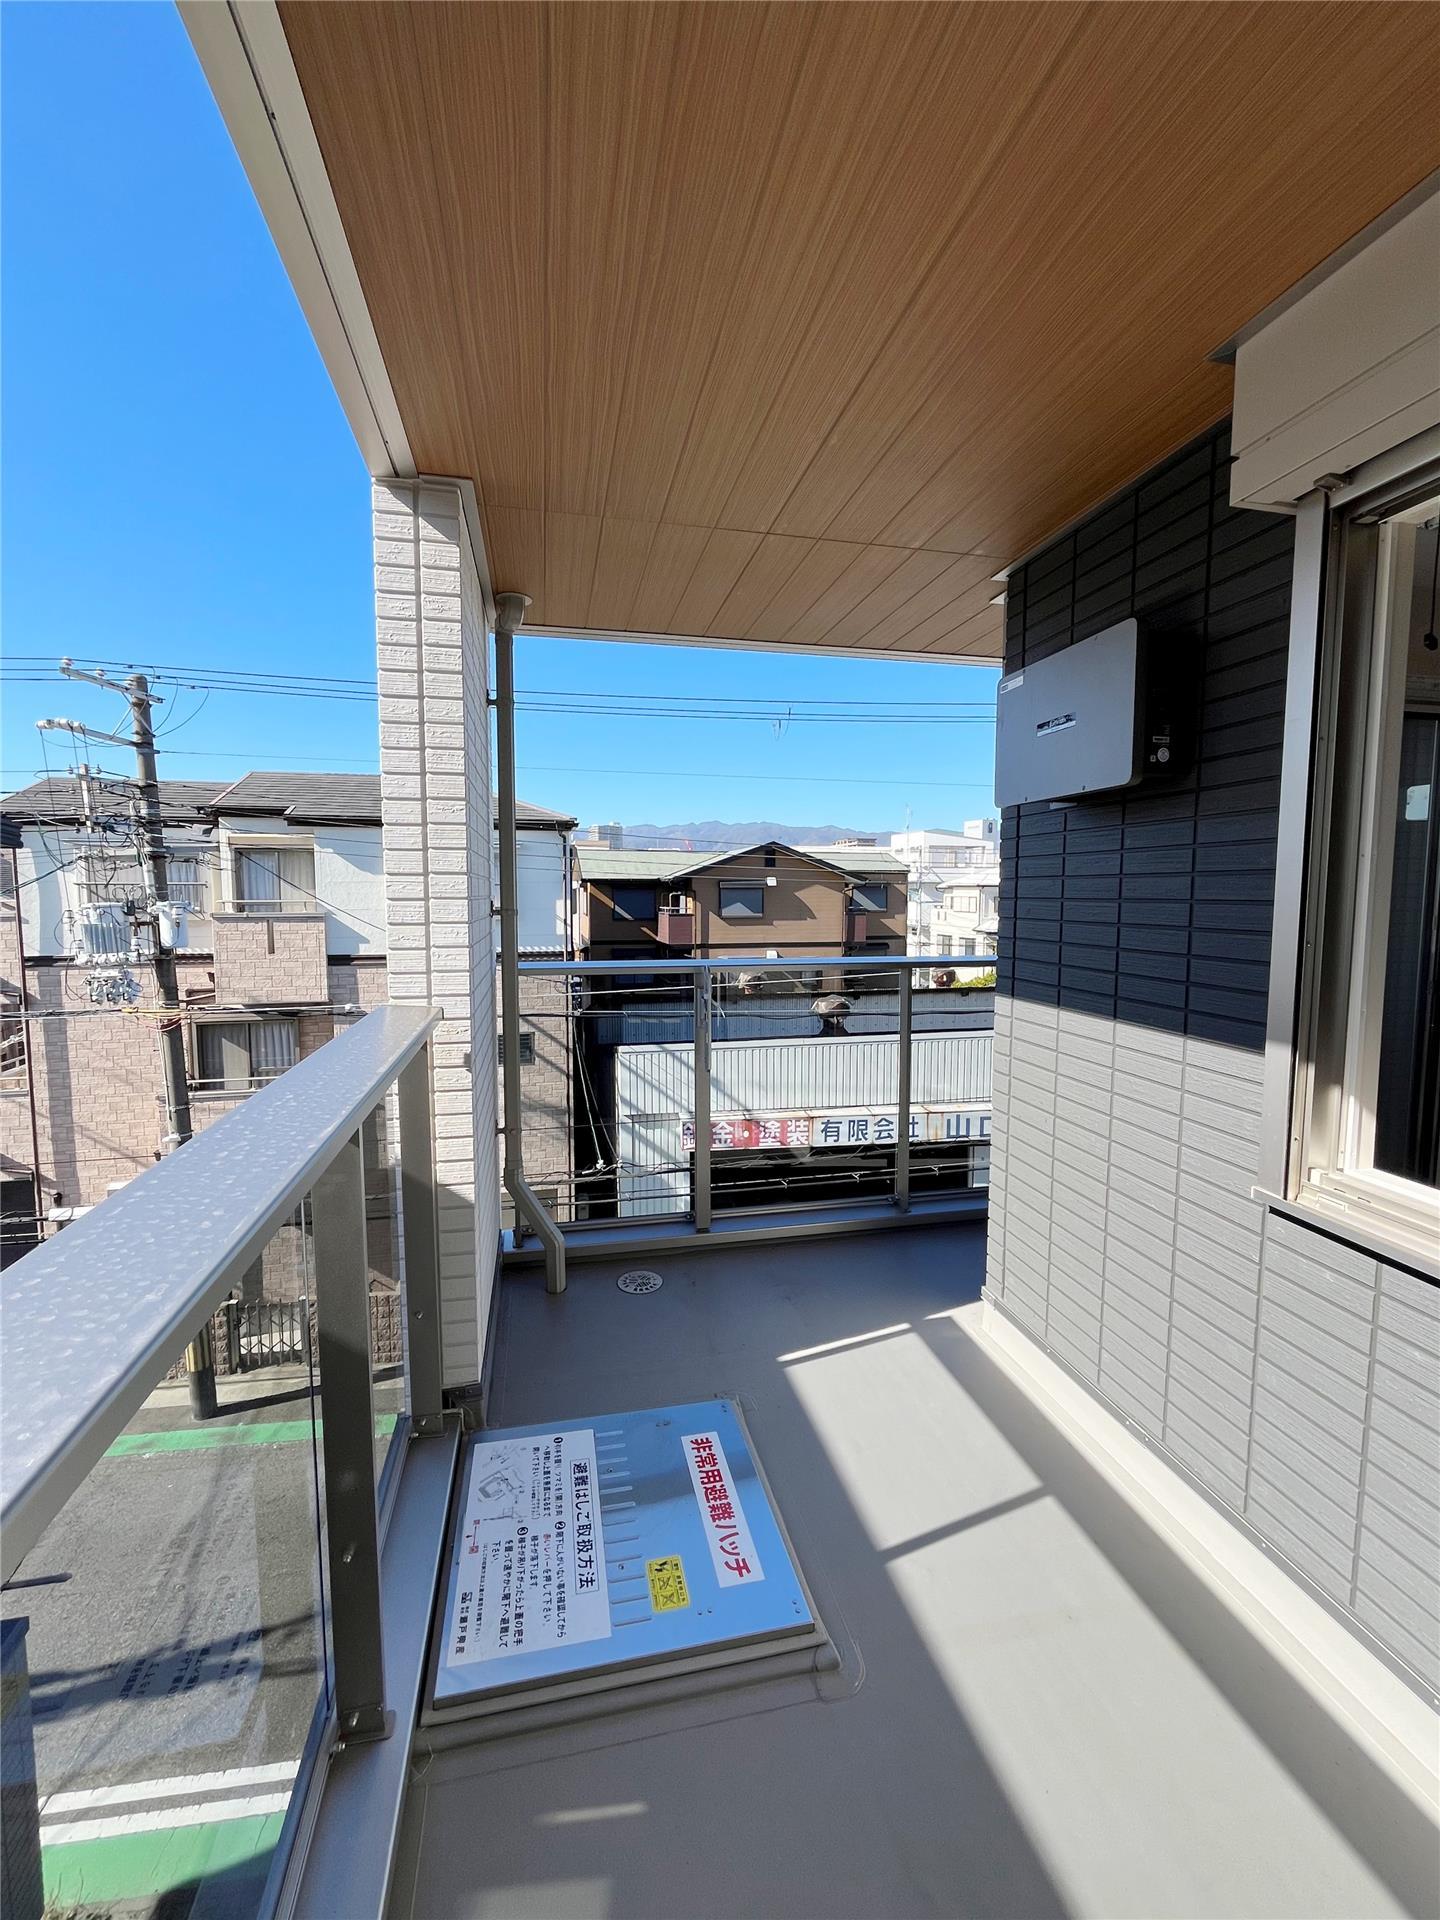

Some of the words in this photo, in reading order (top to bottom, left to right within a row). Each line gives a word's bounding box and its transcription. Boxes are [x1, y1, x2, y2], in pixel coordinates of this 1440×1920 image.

[572, 1462, 597, 1589] 避難はしご取扱方法
[690, 1437, 751, 1578] 非常用避難ハッチ
